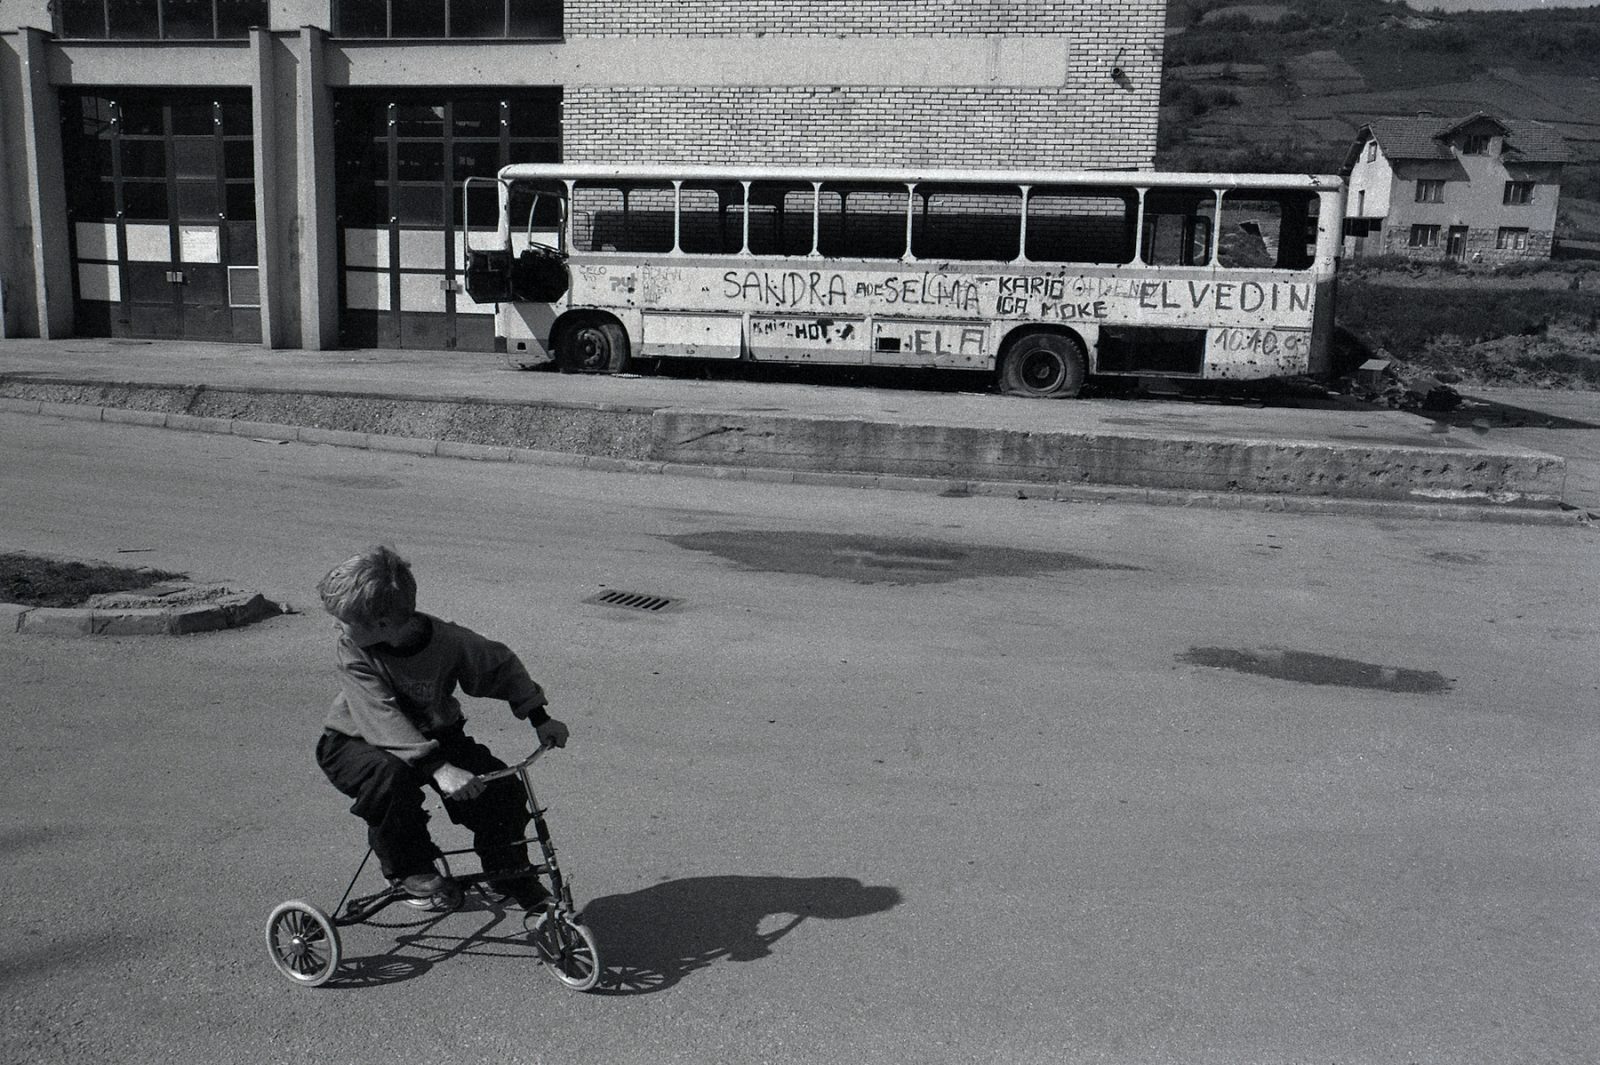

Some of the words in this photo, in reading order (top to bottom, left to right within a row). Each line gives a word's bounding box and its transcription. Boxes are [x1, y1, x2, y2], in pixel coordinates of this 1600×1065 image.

[723, 271, 847, 307] SANDRA
[1139, 280, 1311, 313] ELVEDIN
[1042, 301, 1108, 319] MOKE
